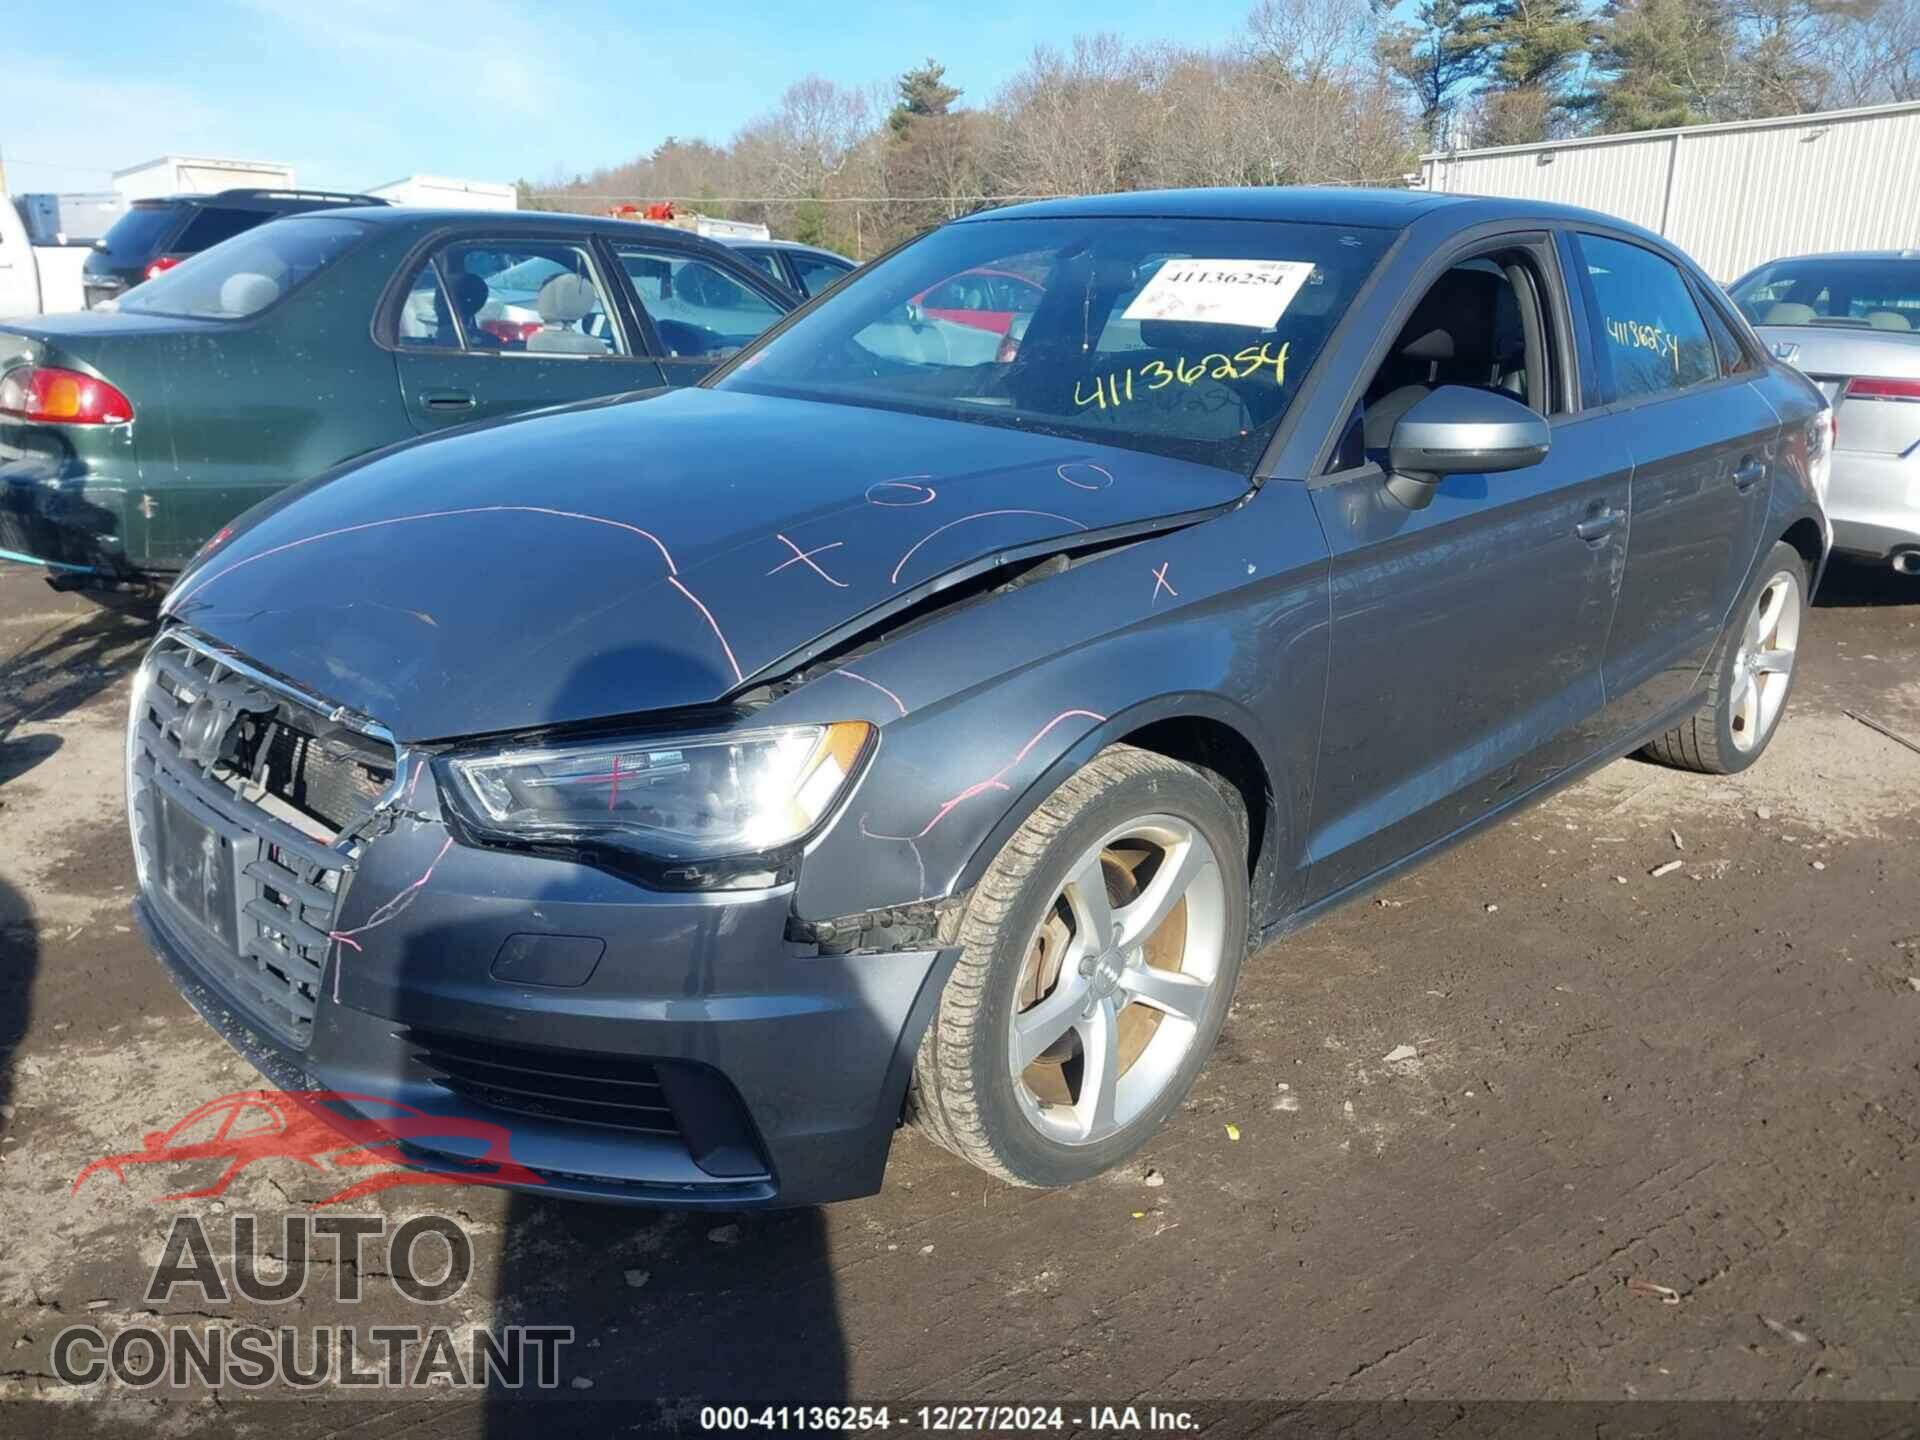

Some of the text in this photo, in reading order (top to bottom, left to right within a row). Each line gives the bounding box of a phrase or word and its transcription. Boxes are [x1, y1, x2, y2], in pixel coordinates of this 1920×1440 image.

[1167, 271, 1285, 287] 41136254
[1606, 316, 1681, 375] 41136254
[1073, 341, 1291, 410] 41136254
